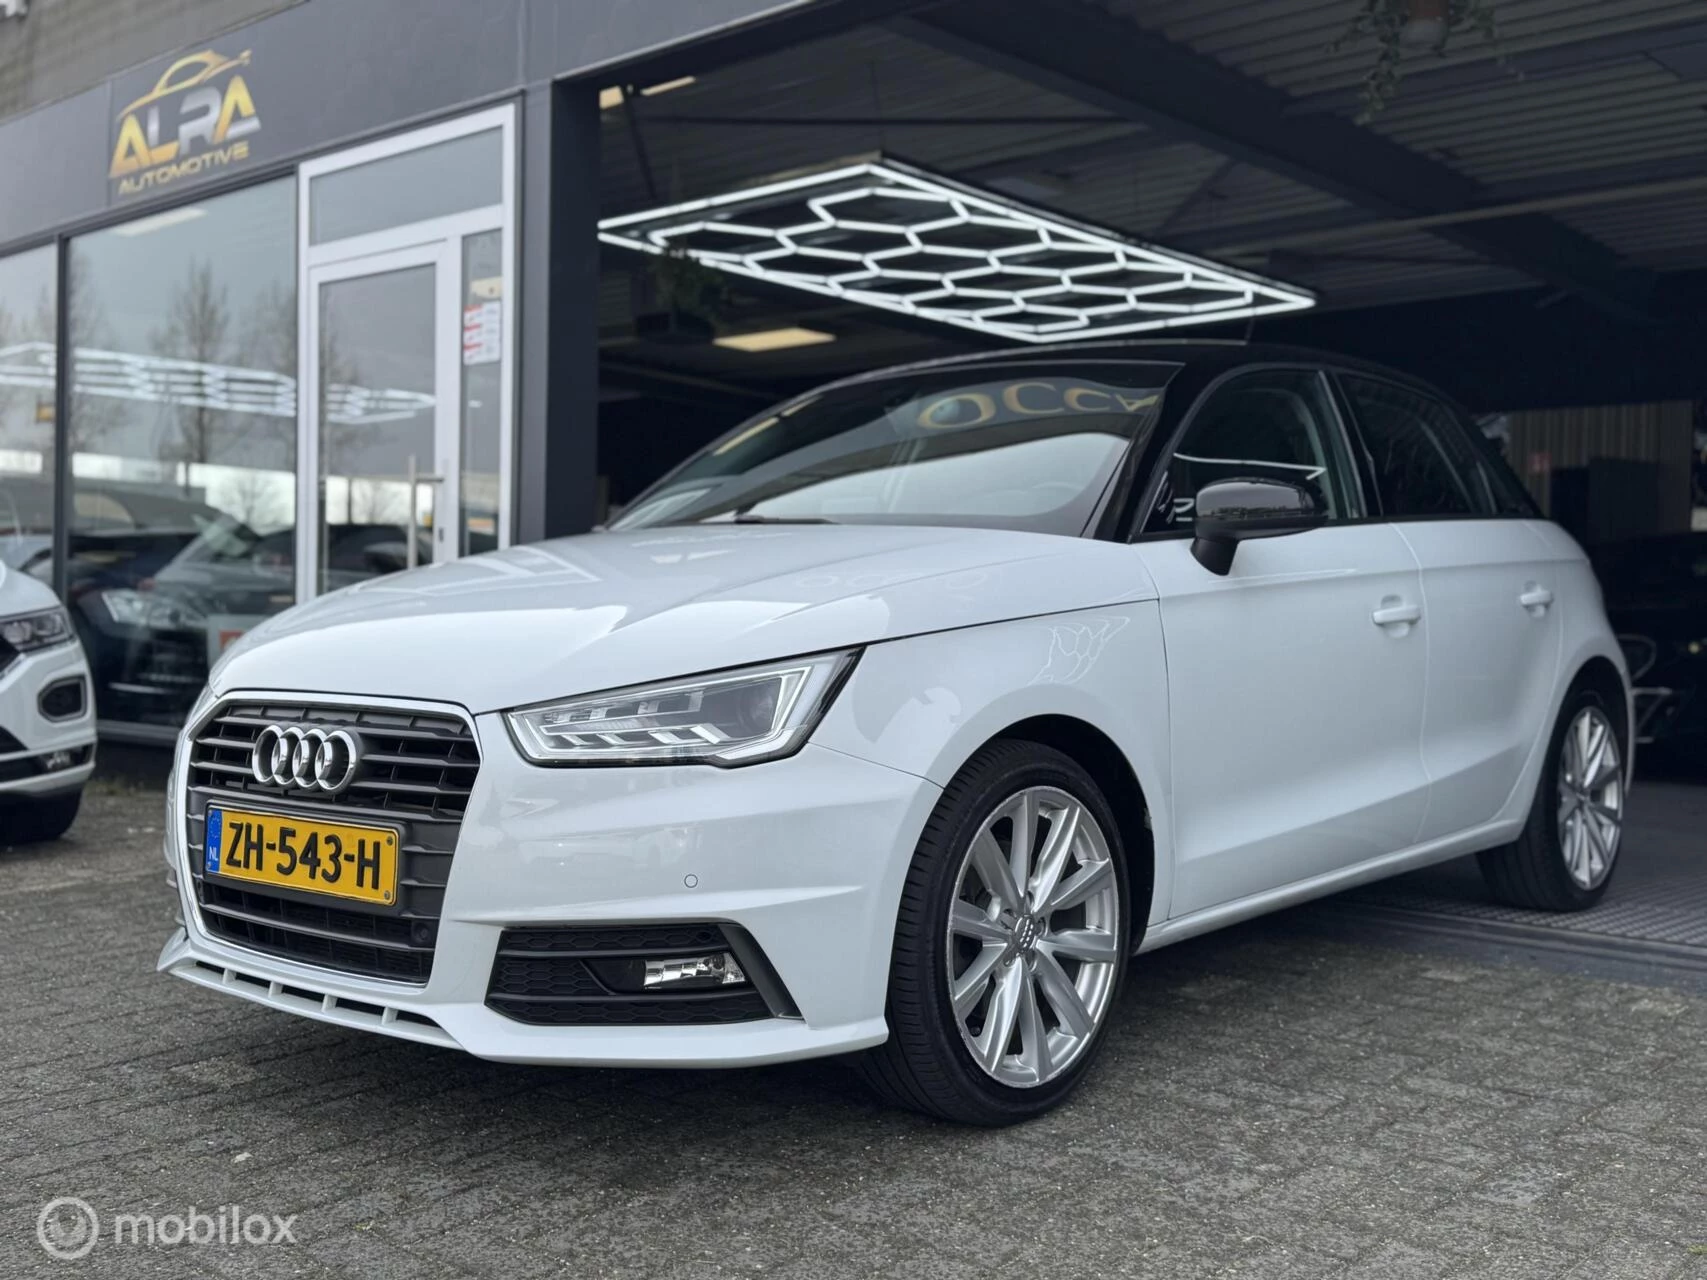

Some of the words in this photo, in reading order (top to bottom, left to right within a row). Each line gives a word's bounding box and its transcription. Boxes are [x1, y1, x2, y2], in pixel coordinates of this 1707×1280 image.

[109, 74, 262, 179] ALRA
[118, 140, 249, 194] AUTOMOTIVE
[208, 846, 219, 861] NL
[226, 821, 381, 890] ZH-543-H
